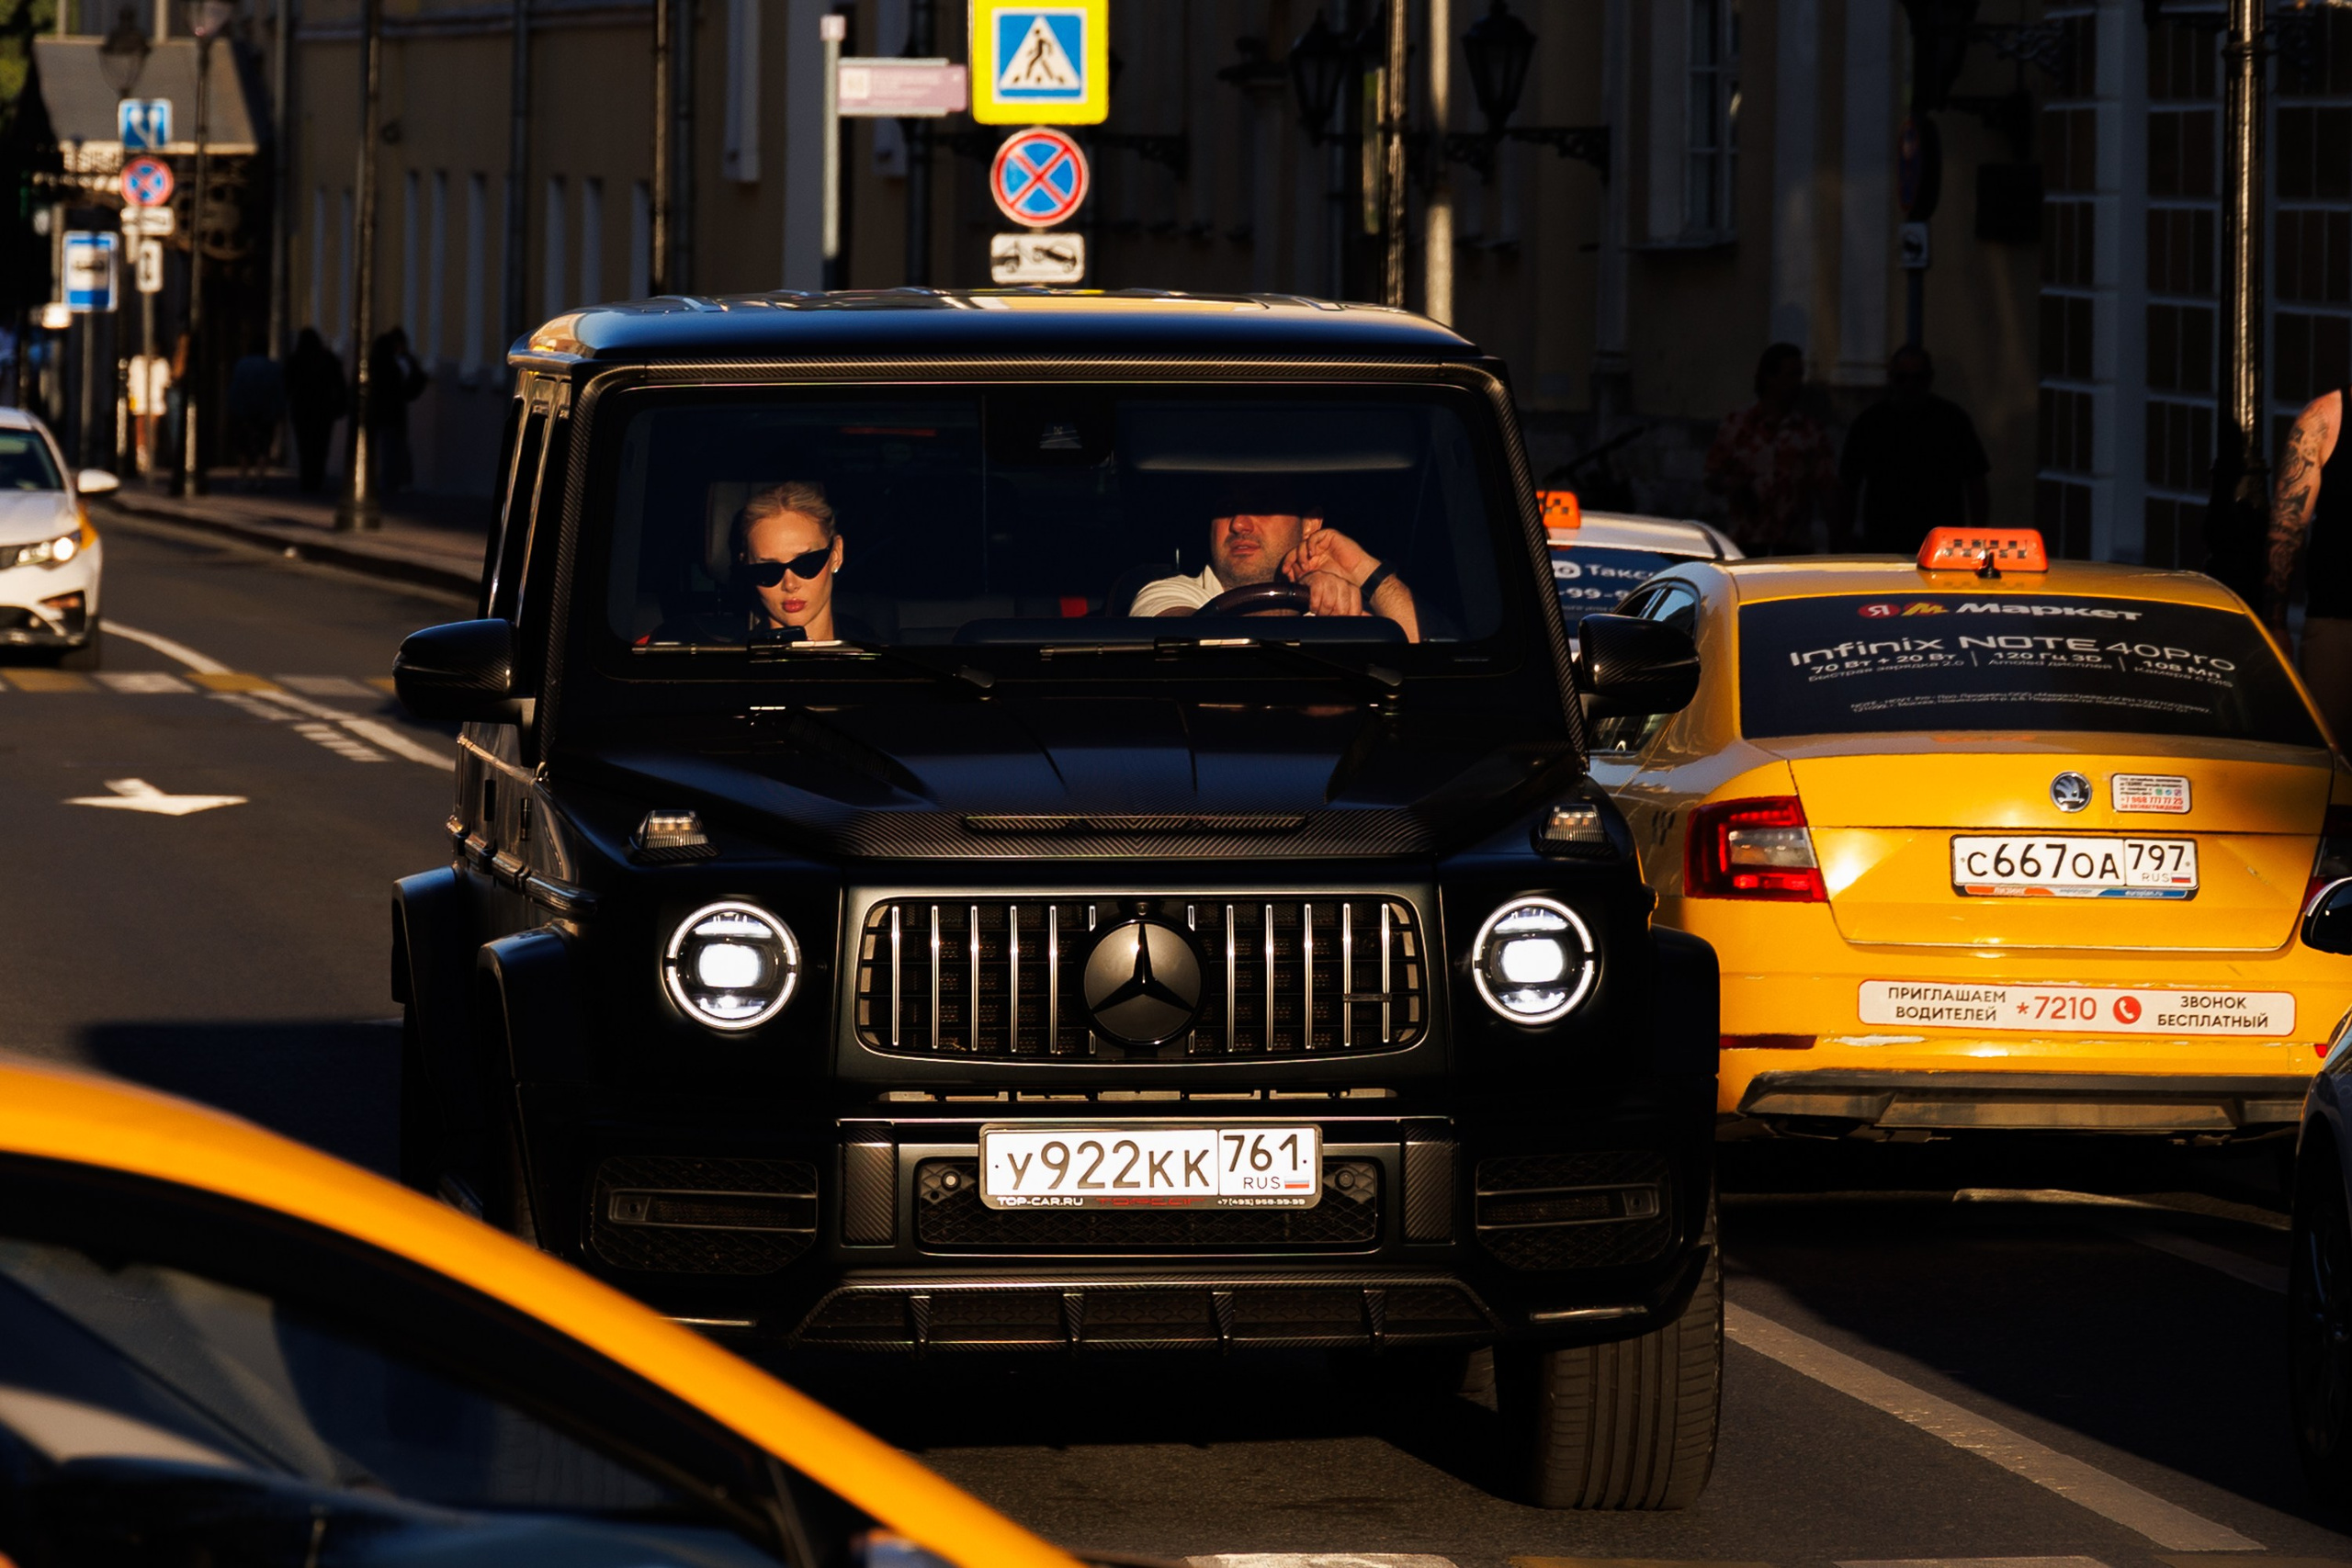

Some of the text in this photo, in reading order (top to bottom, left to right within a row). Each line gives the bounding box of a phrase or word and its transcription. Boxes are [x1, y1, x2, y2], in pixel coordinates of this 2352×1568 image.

[1956, 603, 2143, 620] Маркет
[1790, 637, 1945, 667] Infinix
[1958, 636, 2100, 652] NOTE
[2040, 652, 2072, 661] Гц
[2072, 654, 2102, 662] 3D
[1810, 663, 1839, 674] 70
[1845, 660, 1872, 669] Вт
[1896, 654, 1923, 663] 20
[1928, 653, 1957, 661] Вт
[2143, 660, 2182, 672] 108
[1967, 843, 2186, 879] С667ОА 797
[2142, 873, 2170, 882] RUS
[1888, 987, 2007, 1003] ПРИГЛАШАЕМ
[2180, 996, 2247, 1010] ЗВОНОК
[1896, 1006, 1996, 1021] ВОДИТЕЛЕЙ
[2158, 1012, 2268, 1028] БЕСПЛАТНЫЙ
[1006, 1134, 1298, 1190] У922КК 761
[1244, 1176, 1281, 1190] RUS
[997, 1196, 1083, 1206] TOP-CAR.RU
